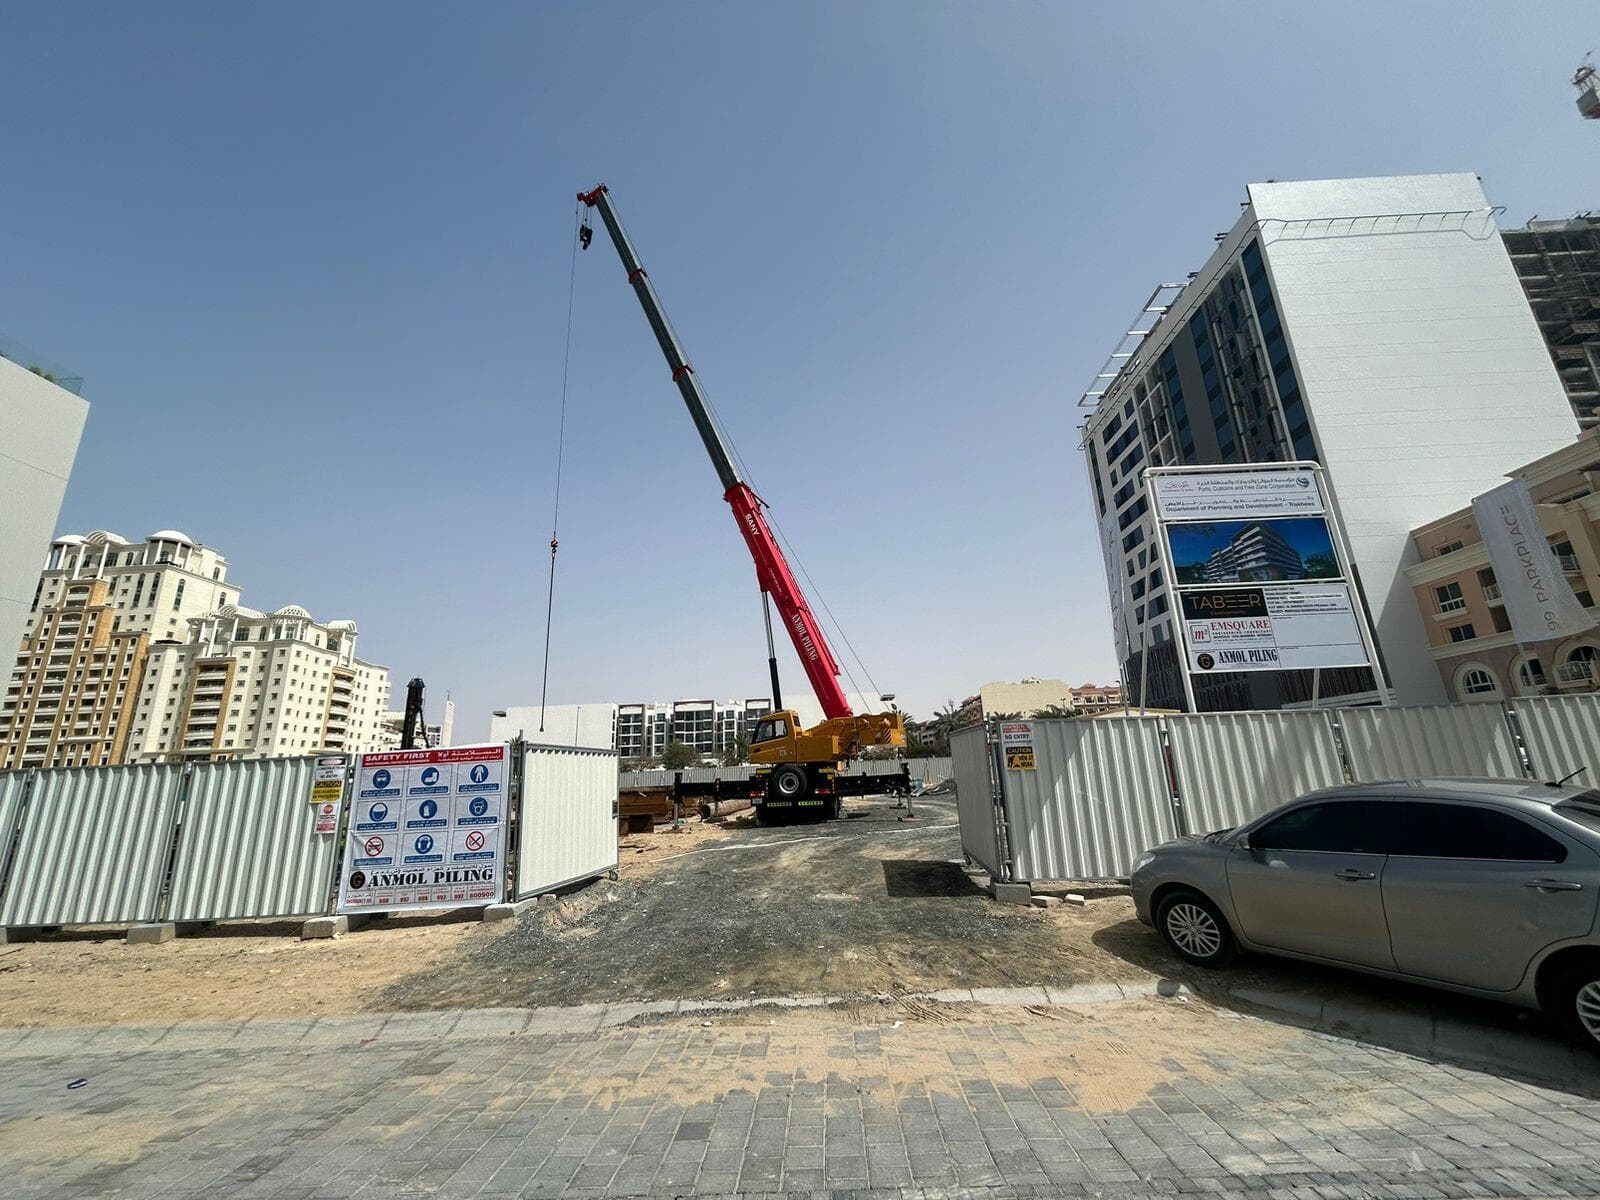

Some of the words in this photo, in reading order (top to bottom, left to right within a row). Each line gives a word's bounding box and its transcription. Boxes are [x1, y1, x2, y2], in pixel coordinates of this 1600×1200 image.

[1269, 482, 1296, 490] Corporation
[1207, 504, 1233, 512] Planning
[1245, 502, 1283, 510] Development
[1210, 619, 1269, 631] EMSQUARE
[1218, 650, 1248, 664] ANMOL
[1247, 648, 1278, 662] PILING
[365, 754, 401, 762] SAFETY
[403, 752, 431, 760] FIRST
[368, 872, 428, 887] ANMOL
[433, 868, 494, 883] PILING
[468, 891, 494, 899] 800900
